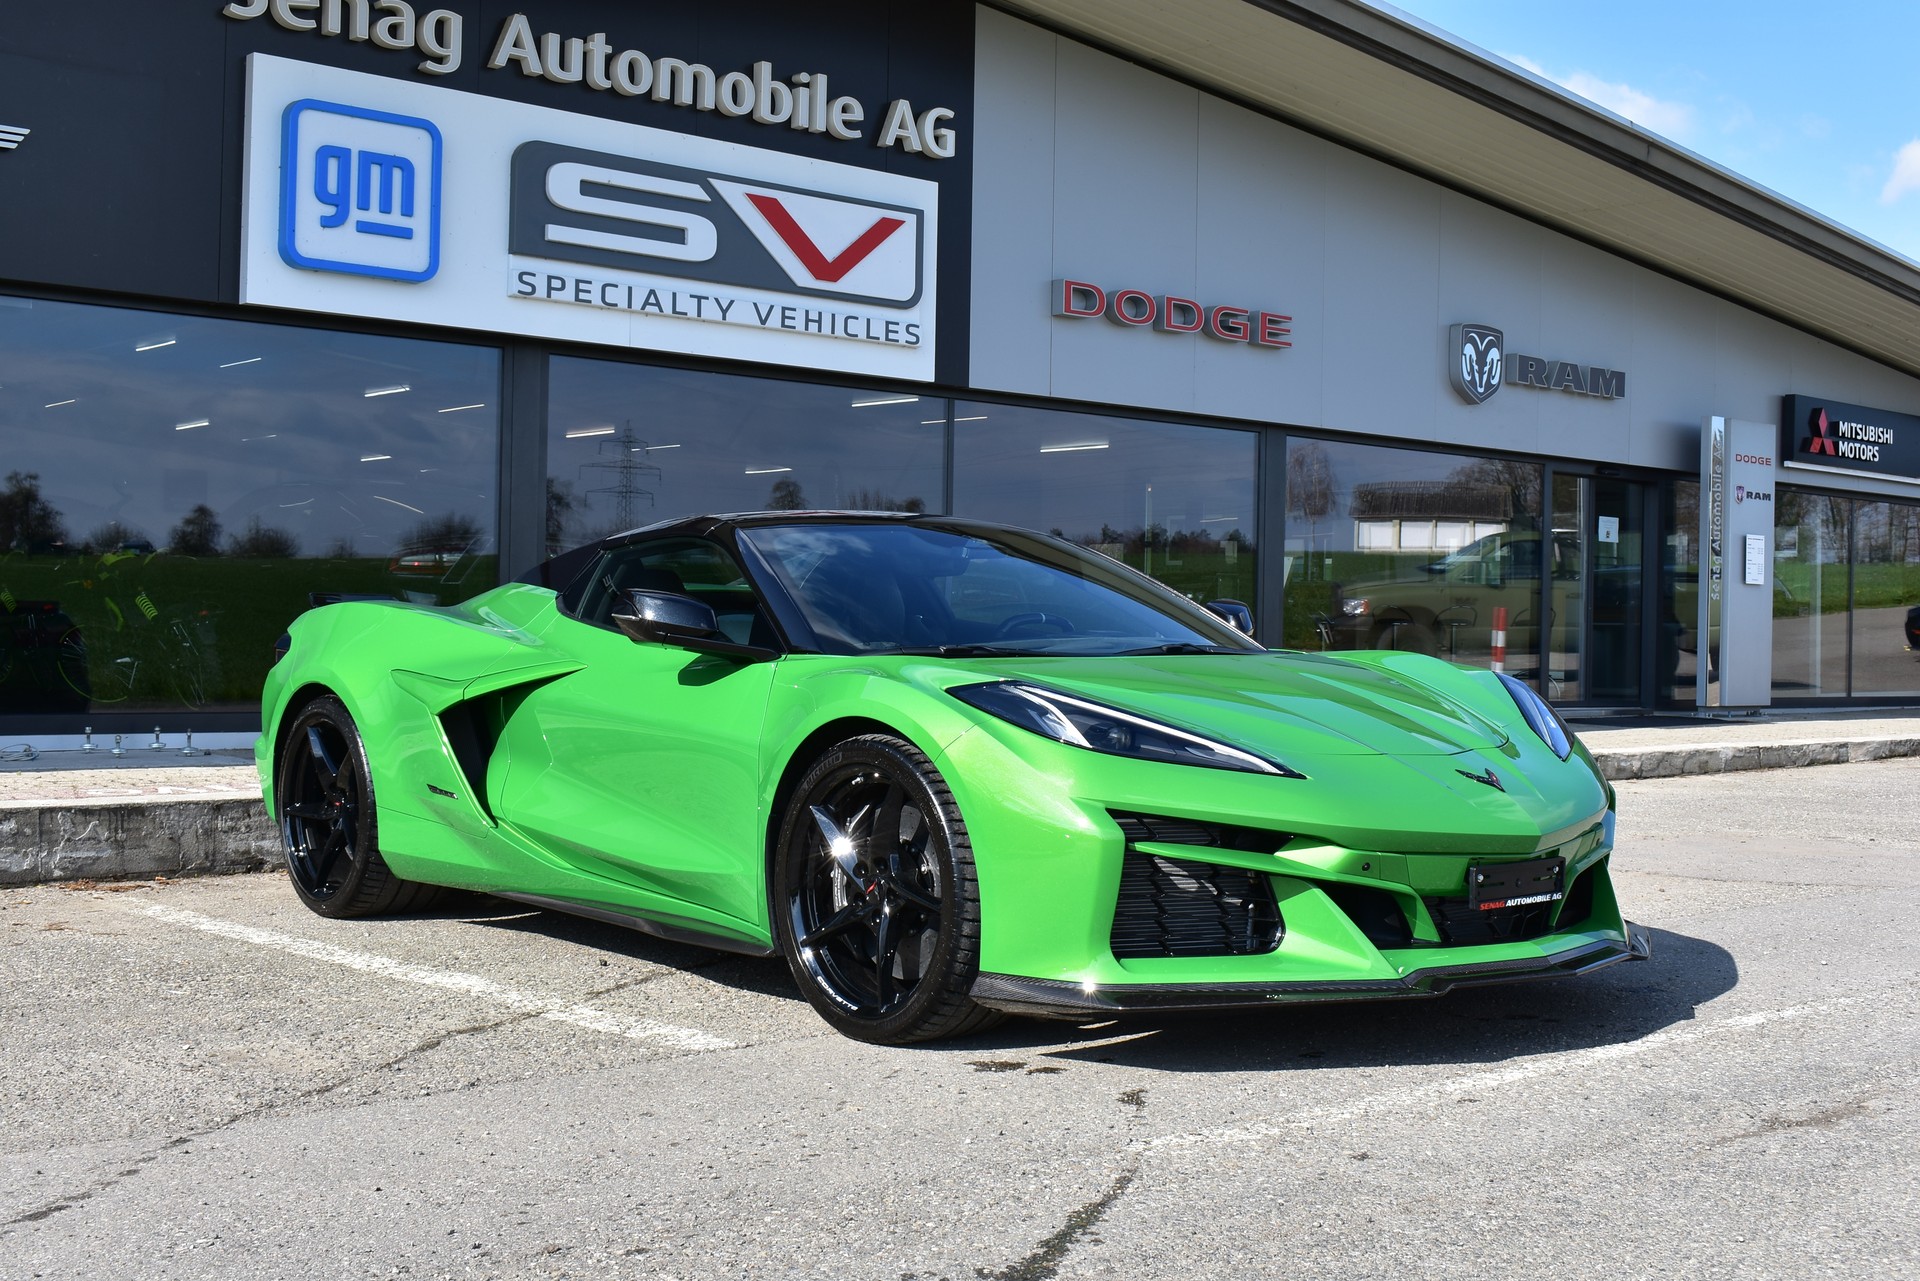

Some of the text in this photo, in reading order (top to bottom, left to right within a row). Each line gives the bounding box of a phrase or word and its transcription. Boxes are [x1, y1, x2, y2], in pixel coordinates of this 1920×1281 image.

[223, 0, 956, 159] enag Automobile AG
[314, 144, 415, 239] gm
[517, 271, 921, 346] SPECIALTY VEHICLES
[1053, 279, 1293, 349] DODGE
[1507, 352, 1626, 400] RAM
[1839, 421, 1893, 444] MITSUBISHI
[1839, 441, 1879, 461] MOTORS
[1736, 454, 1771, 465] DODGE
[1712, 464, 1722, 551] Automobile
[1746, 491, 1771, 501] RAM
[1480, 892, 1562, 910] SENAG AUTOMOBILE AG
[817, 975, 859, 1011] CORVETTE
